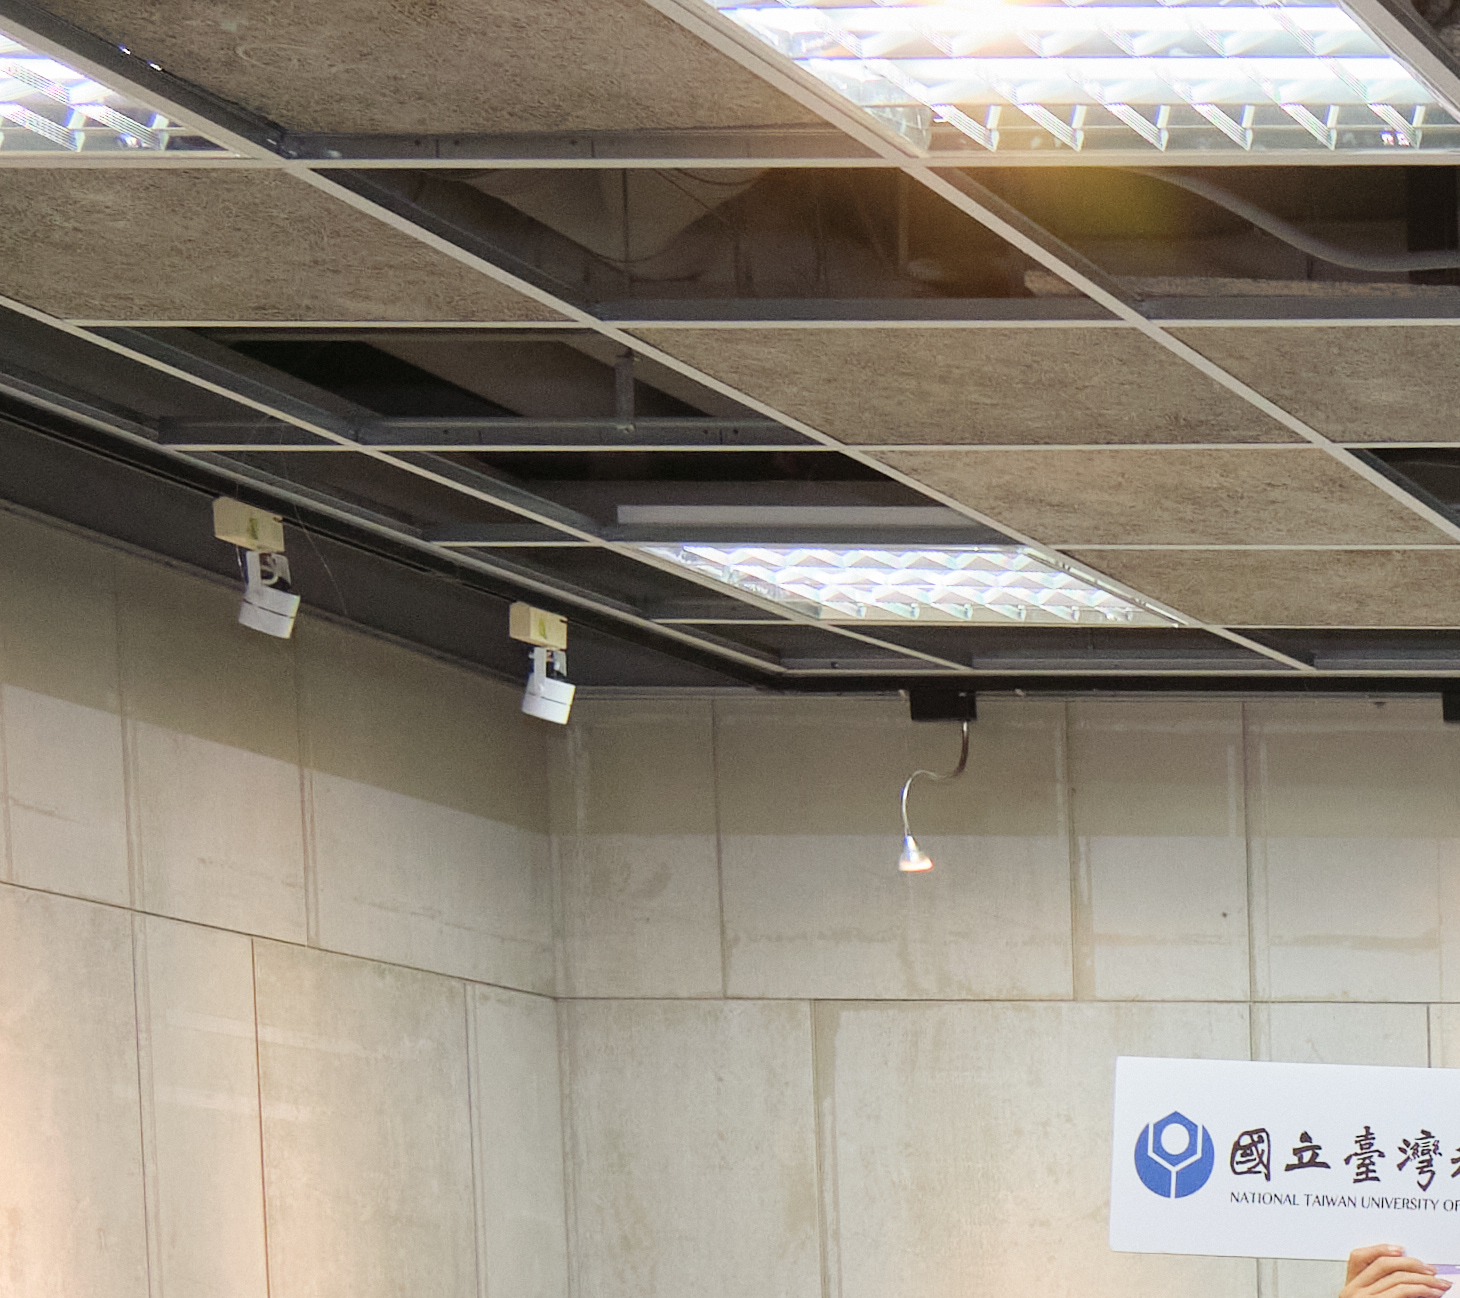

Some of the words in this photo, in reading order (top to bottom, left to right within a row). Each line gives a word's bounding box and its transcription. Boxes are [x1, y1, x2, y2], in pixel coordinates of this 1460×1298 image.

[1230, 1191, 1299, 1206] NATIONAL
[1304, 1193, 1357, 1208] TAIWAN
[1361, 1196, 1439, 1212] UNIVERSITY
